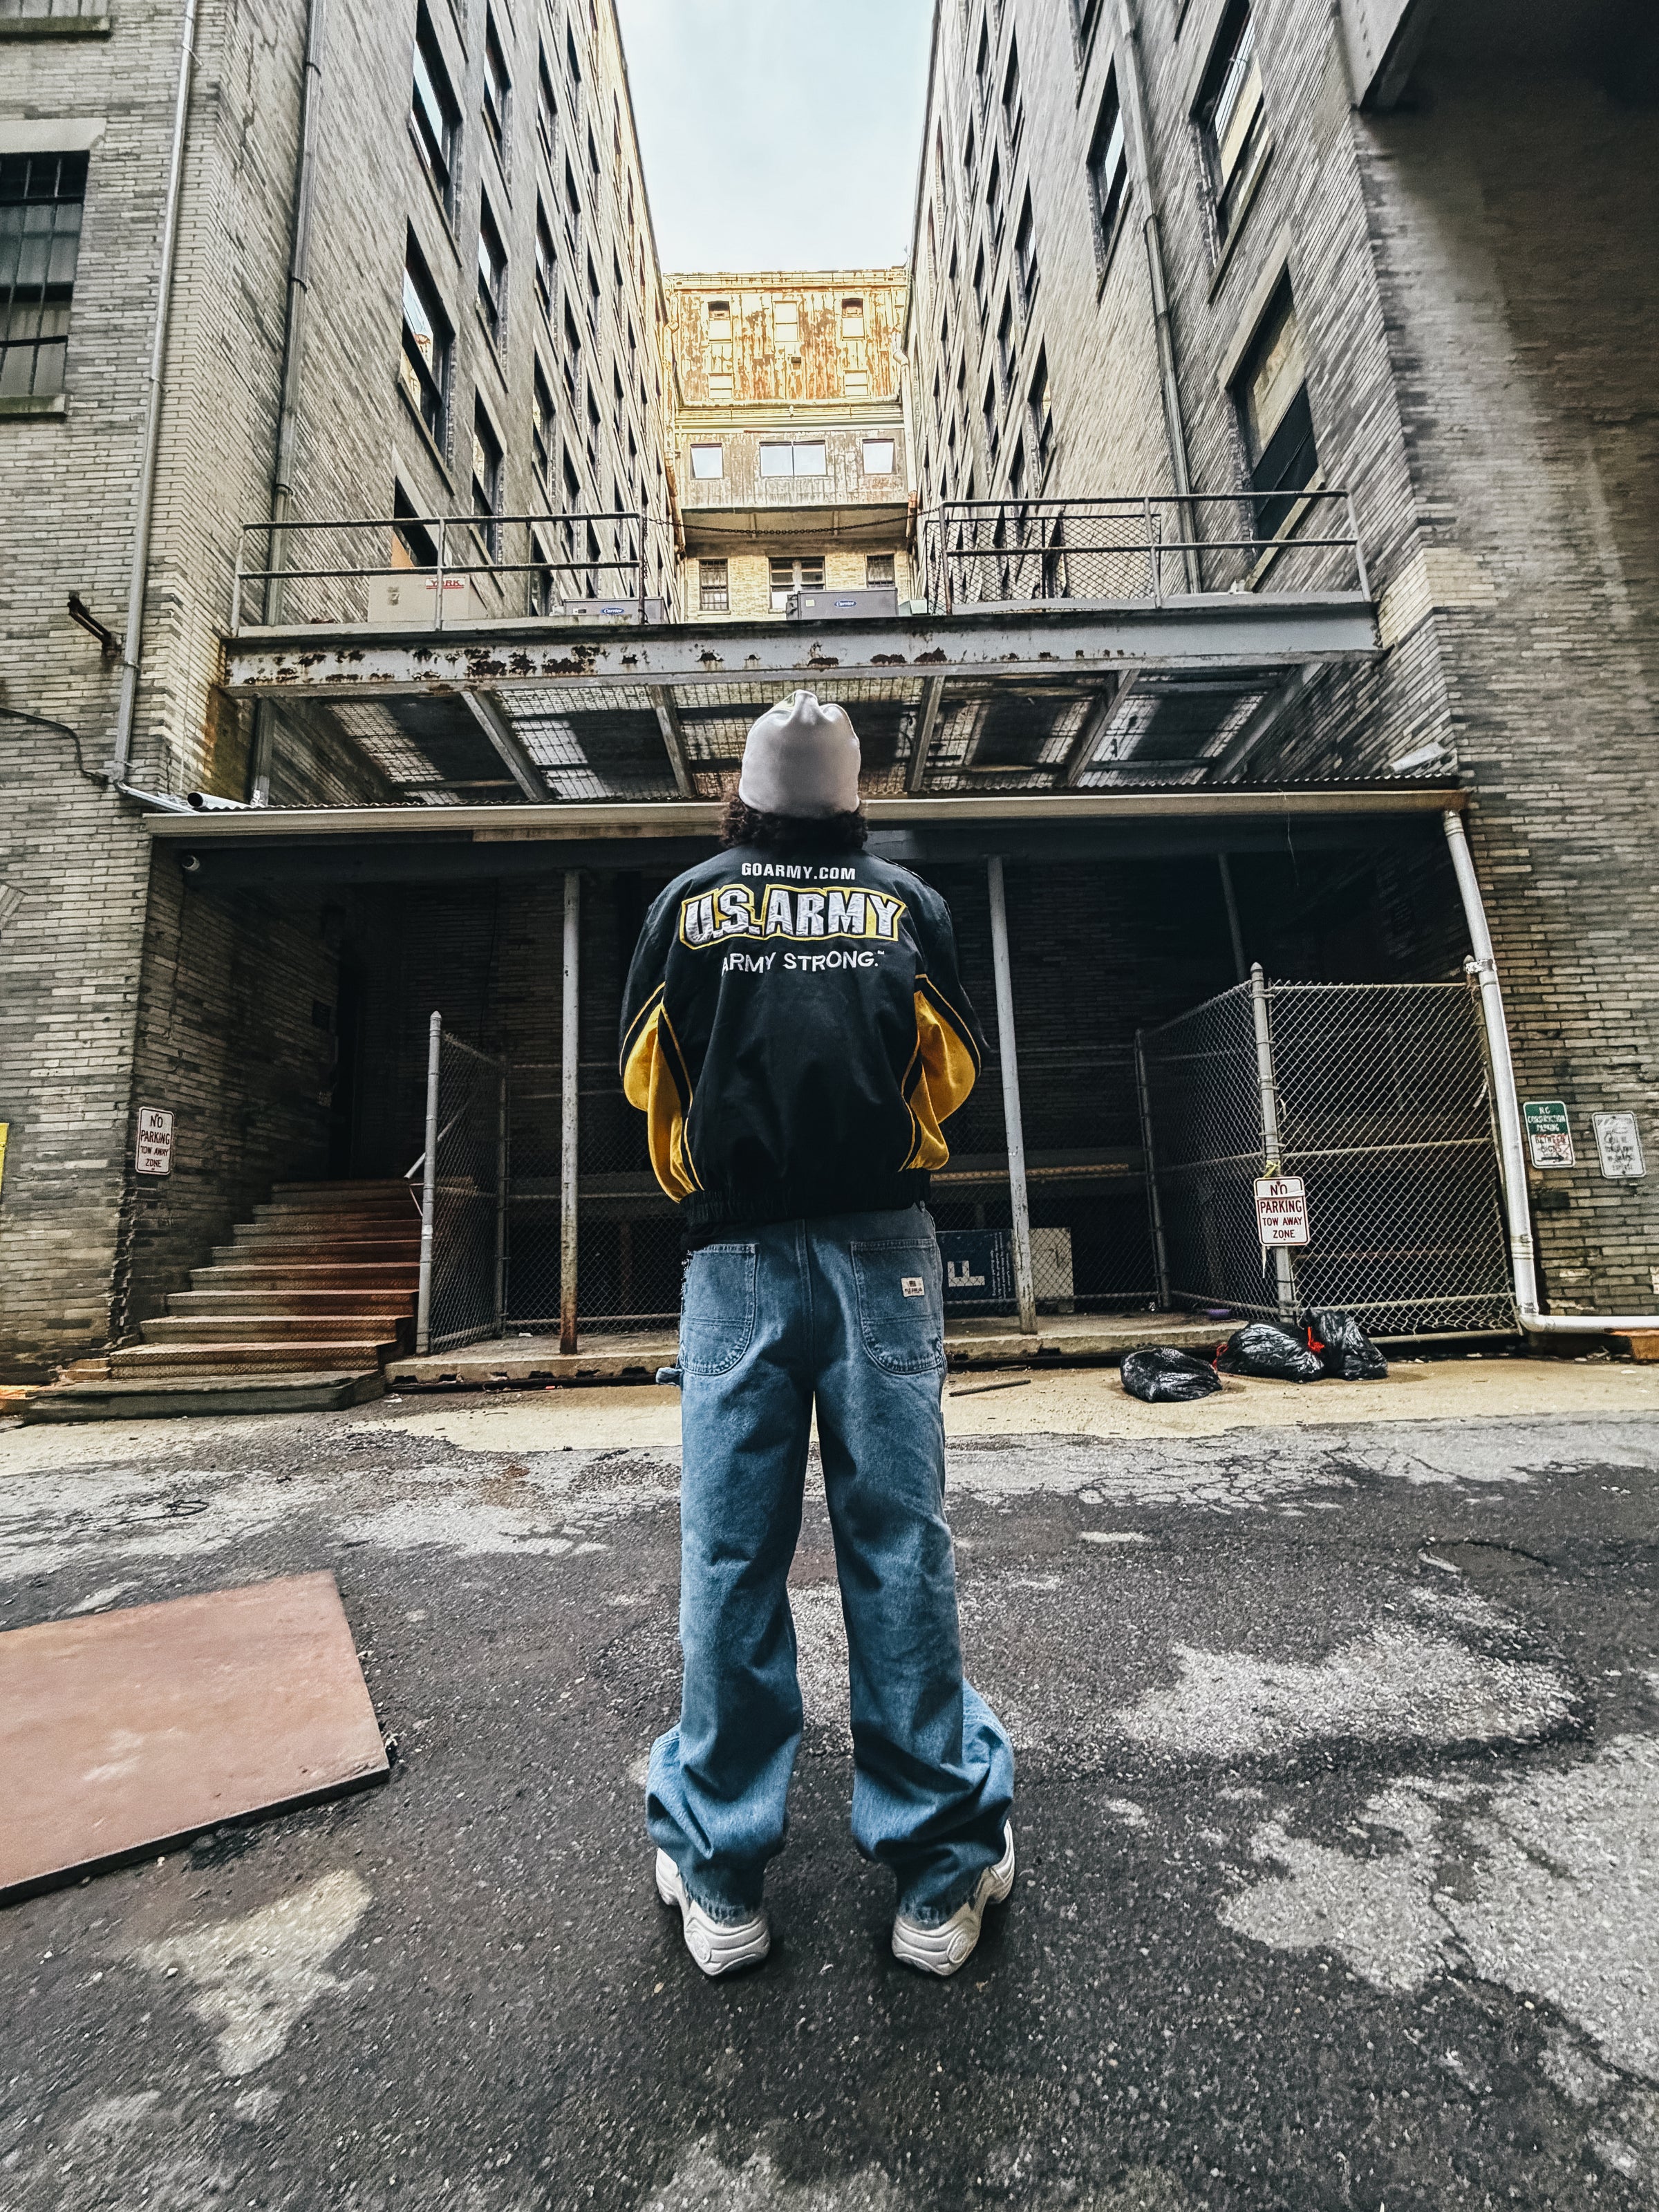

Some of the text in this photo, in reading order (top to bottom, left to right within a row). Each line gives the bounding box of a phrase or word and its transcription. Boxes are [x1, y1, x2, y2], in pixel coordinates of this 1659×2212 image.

[742, 863, 856, 880] GOARMY.COM
[765, 889, 899, 937] ARMY
[149, 1115, 163, 1128] NO
[140, 1130, 171, 1145] PARKING
[140, 1145, 169, 1156] TOW AWAY
[145, 1158, 162, 1168] ZONE
[1270, 1184, 1288, 1196] NO
[1260, 1200, 1302, 1213] PARKING
[1262, 1217, 1302, 1226] TOW AWAY
[1273, 1229, 1295, 1239] ZONE
